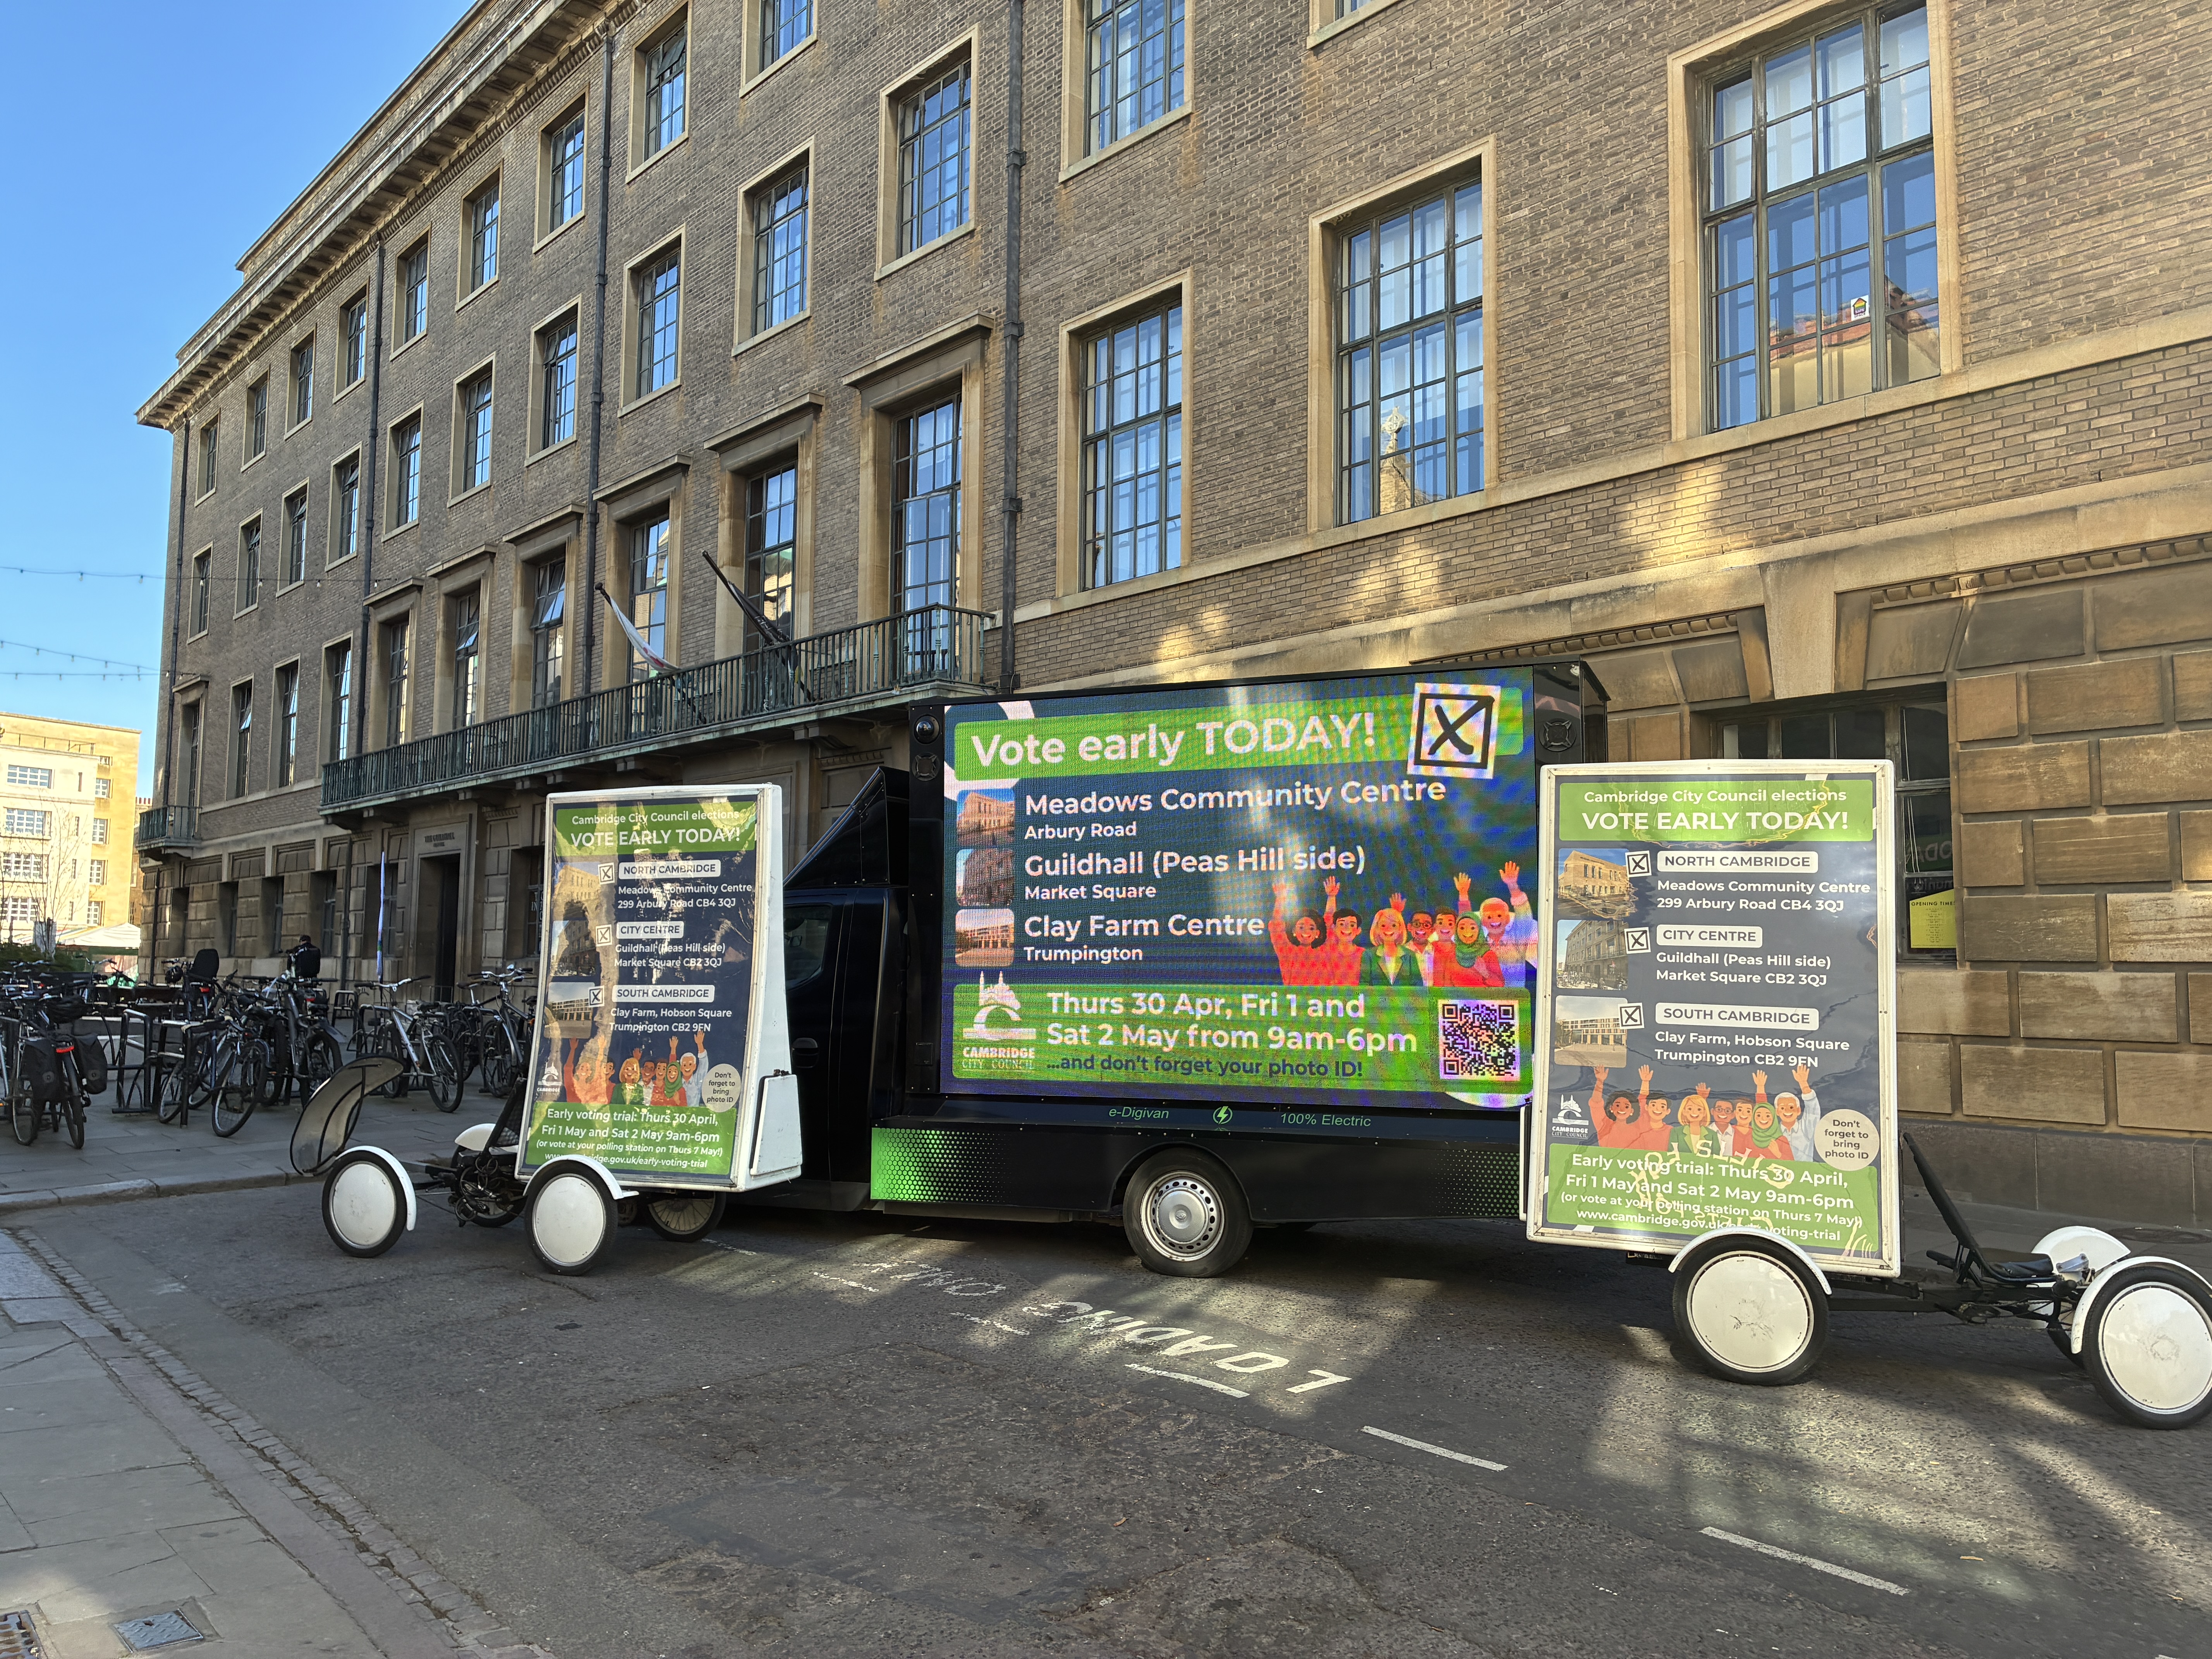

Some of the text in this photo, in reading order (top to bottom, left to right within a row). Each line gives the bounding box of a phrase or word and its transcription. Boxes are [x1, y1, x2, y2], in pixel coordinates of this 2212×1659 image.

[972, 713, 1374, 766] Vote early TODAY!
[1026, 780, 1447, 814] Meadows Community Centre
[1584, 789, 1846, 804] Cambridge City Council elections
[572, 811, 740, 825] Cambridge City Council elections
[1582, 812, 1848, 830] VOTE EARLY TODAY!
[571, 828, 740, 847] VOTE EARLY TODAY!
[1024, 821, 1137, 842] Arbury Road
[624, 864, 716, 874] NORTH CAMBRIDGE
[1025, 845, 1366, 878] Guildhall (Peas Hill side)
[1665, 856, 1810, 867] NORTH CAMBRIDGE
[1025, 884, 1157, 901] Market Square
[1658, 880, 1871, 895] Meadows Community Centre
[1657, 898, 1844, 913] 299 Arbury Road CB4 3QJ
[643, 925, 680, 934] CENTRE
[1024, 914, 1265, 941] Clay Farm Centre
[1663, 930, 1756, 941] CITY CENTRE
[1024, 945, 1143, 965] Trumpington
[1657, 952, 1831, 969] Guildhall (Peas Hill side)
[1657, 970, 1827, 987] Market Square CB2 3QJ
[617, 989, 709, 997] SOUTH CAMBRIDGE
[610, 1008, 732, 1019] Clay Farm, Hobson Square
[1048, 991, 1366, 1020] Thurs 30 Apr, Fri 1 and
[1664, 1008, 1810, 1024] SOUTH CAMBRIDGE
[609, 1022, 711, 1033] Trumpington CB2 9FN
[1047, 1022, 1417, 1056] Sat 2 May from 9am-6pm
[1655, 1031, 1850, 1051] Clay Farm, Hobson Square
[963, 1047, 1035, 1058] CAMBRIDGE
[1655, 1049, 1818, 1068] Trumpington CB2 9FN
[1047, 1055, 1362, 1080] ...and don't forget your photo ID!
[547, 1108, 718, 1127] Early voting trial: Thurs 30 April,
[1109, 1107, 1169, 1120] e-Digivan
[1281, 1113, 1371, 1127] 100% Electric
[1833, 1120, 1860, 1128] Don't
[542, 1125, 720, 1143] Fri 1 May and Sat 2 May 9am-6pm
[1825, 1129, 1855, 1139] forget
[1833, 1140, 1860, 1150] bring
[1825, 1150, 1855, 1158] photo
[1572, 1154, 1848, 1188] Early voting trial: Thurs 30 April,
[1566, 1174, 1854, 1210] Fri 1 May and Sat 2 May 9am-6pm
[1561, 1192, 1577, 1203] (or
[1580, 1195, 1607, 1204] vote
[1610, 1197, 1623, 1206] at
[1625, 1199, 1654, 1208] your
[1657, 1200, 1700, 1212] polling
[1704, 1204, 1749, 1216] station
[1753, 1209, 1769, 1218] on
[1773, 1209, 1811, 1222] Thurs
[1814, 1213, 1823, 1223] 7
[1022, 1300, 1352, 1393] LOADING
